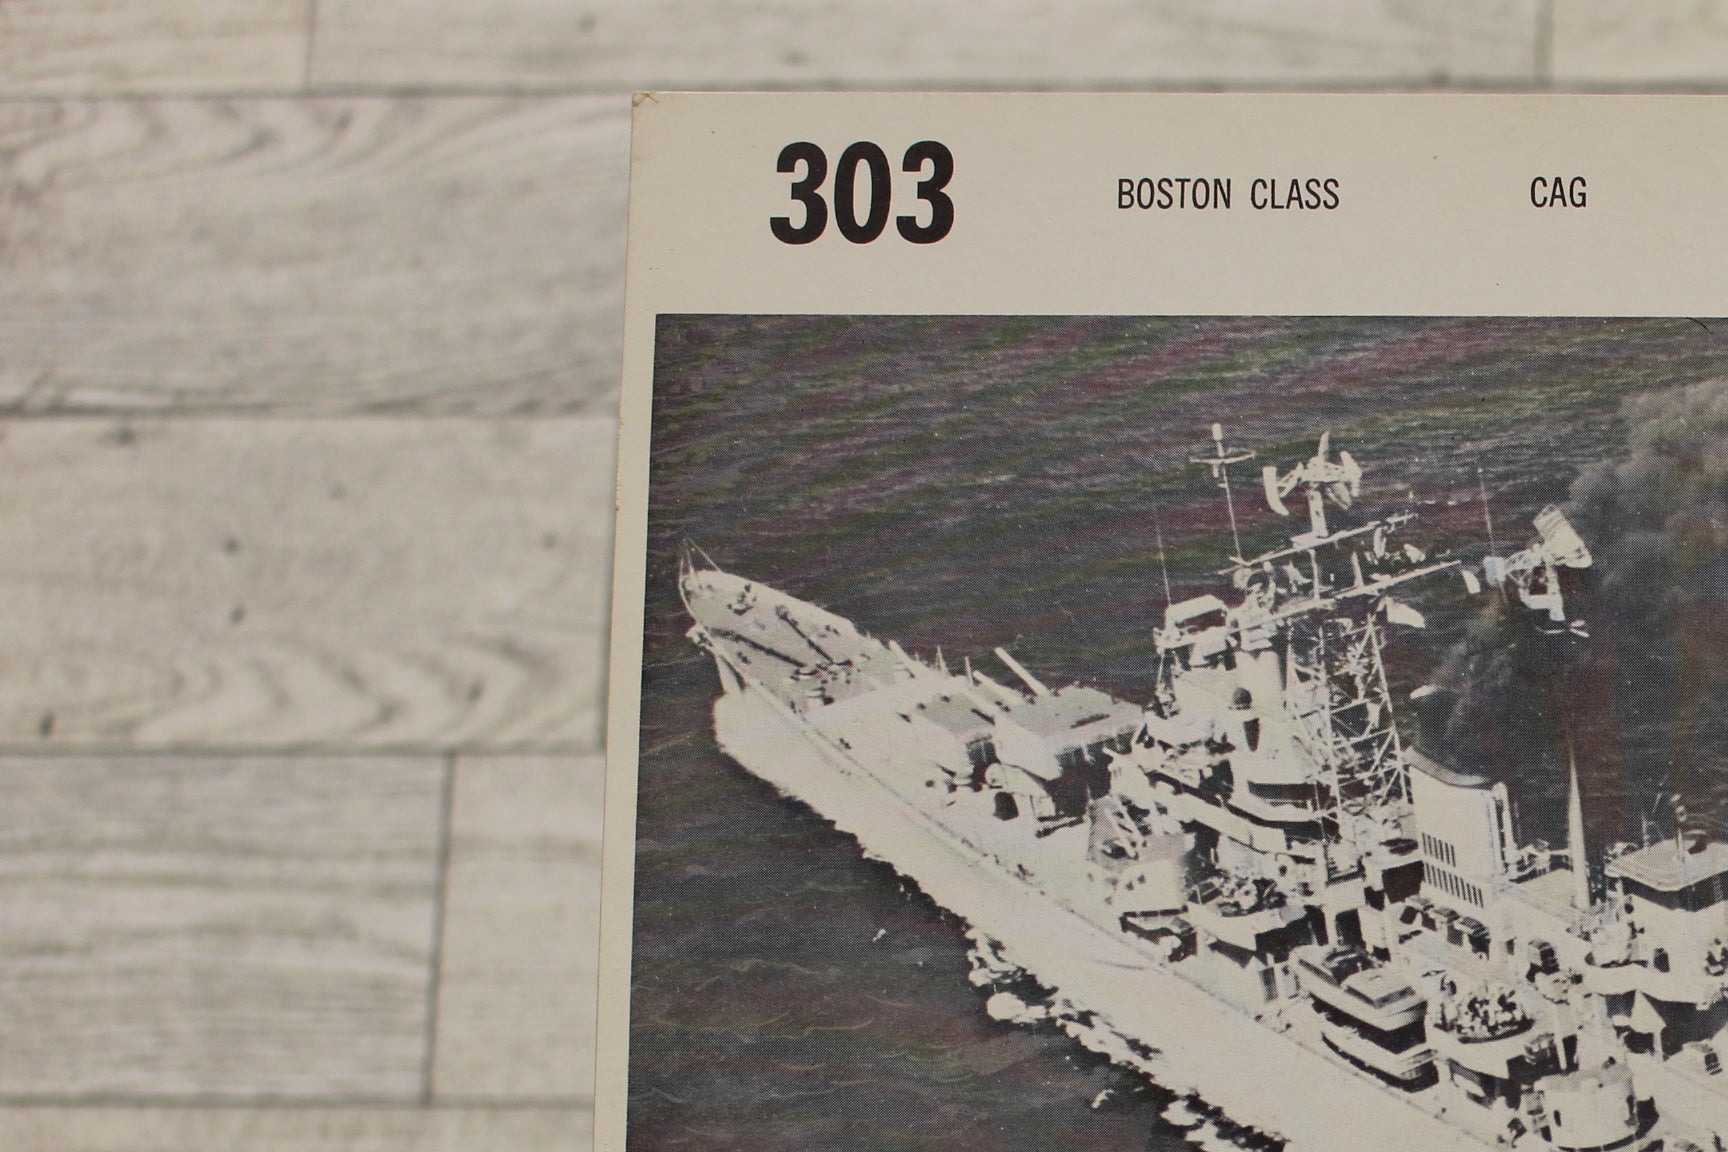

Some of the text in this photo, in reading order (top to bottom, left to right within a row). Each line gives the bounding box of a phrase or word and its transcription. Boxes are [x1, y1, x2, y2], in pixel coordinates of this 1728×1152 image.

[769, 140, 955, 246] 303
[1117, 176, 1341, 210] BOSTON CLASS
[1529, 175, 1588, 209] CAG
